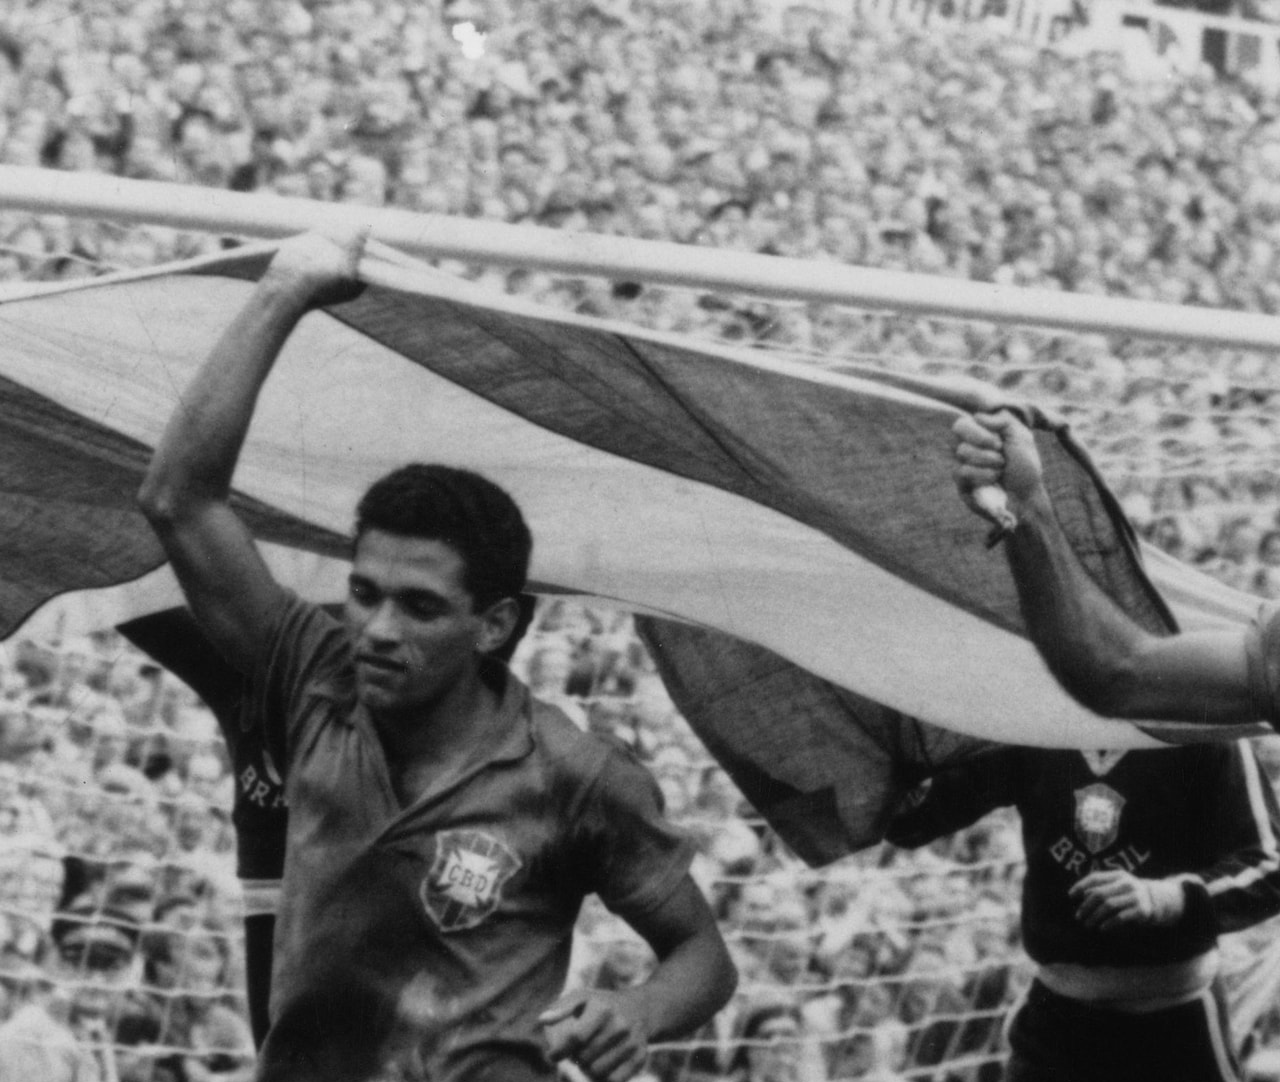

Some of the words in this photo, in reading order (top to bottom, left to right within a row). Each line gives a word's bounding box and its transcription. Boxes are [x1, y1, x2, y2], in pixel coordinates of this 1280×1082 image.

[240, 764, 289, 808] BRA
[1050, 836, 1151, 876] BRASIL
[447, 864, 488, 893] CBD
